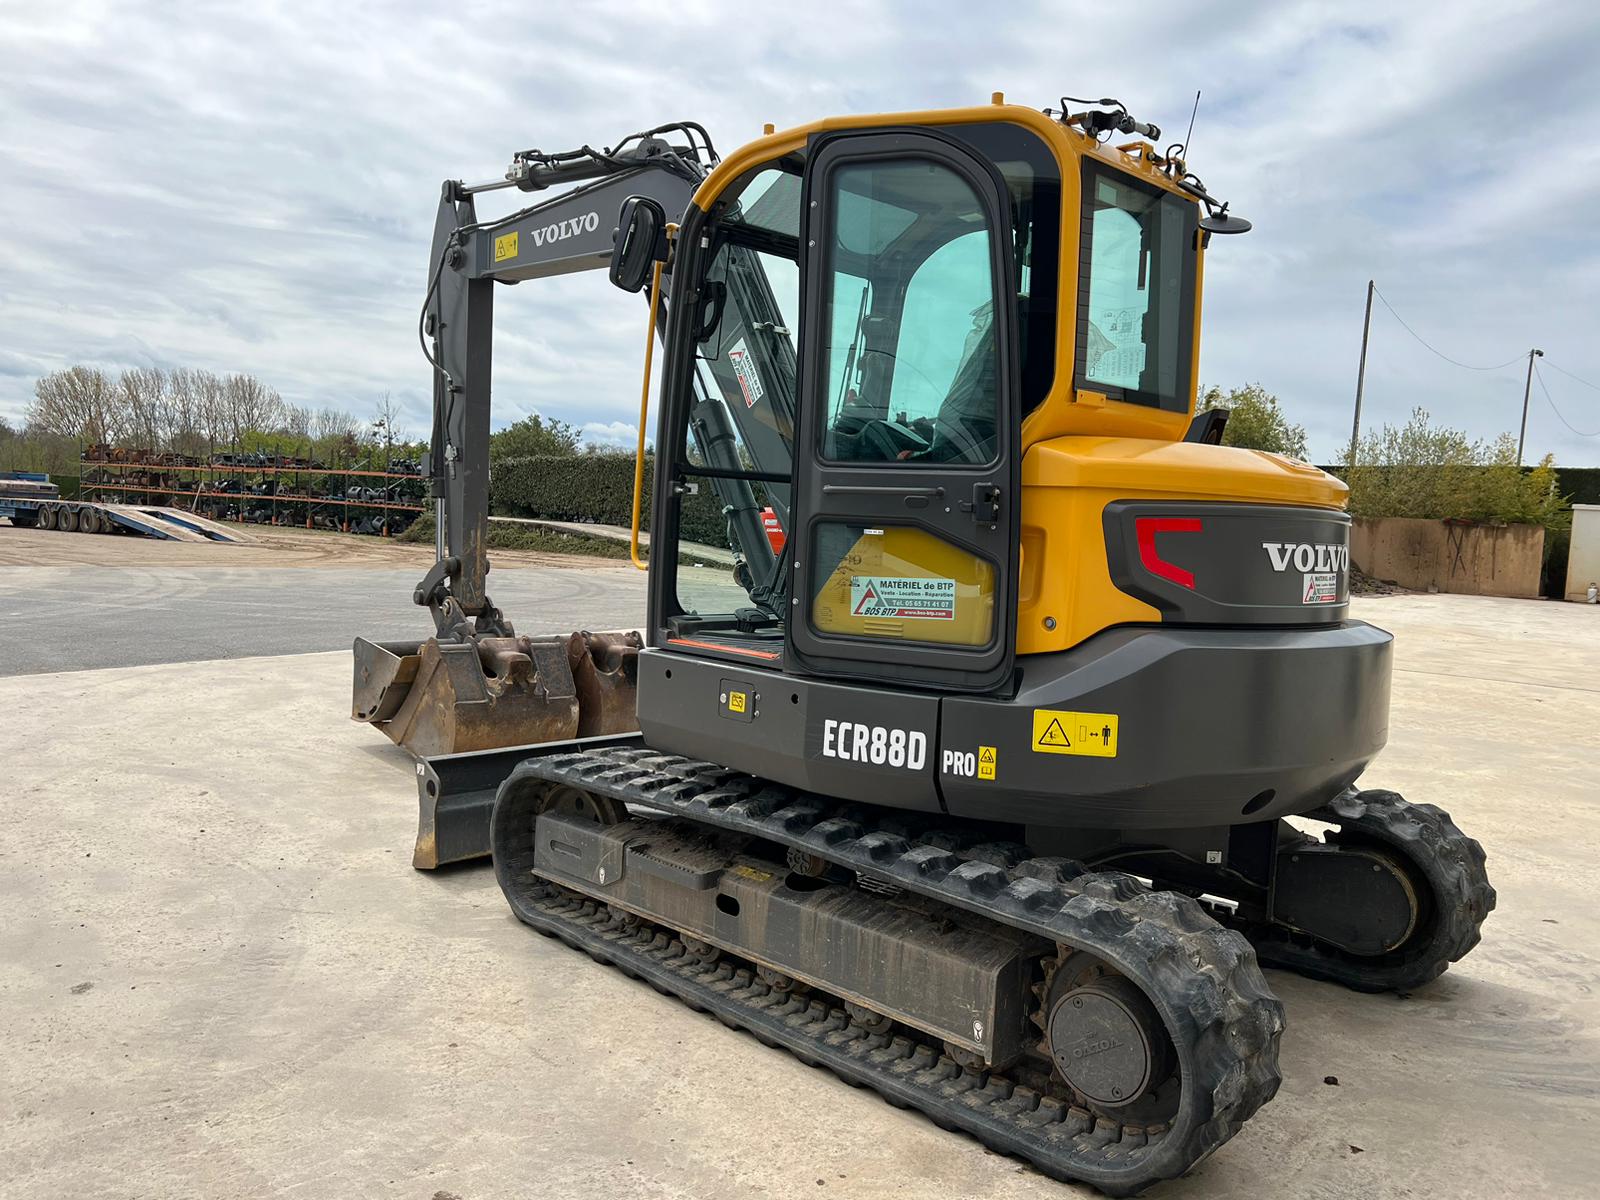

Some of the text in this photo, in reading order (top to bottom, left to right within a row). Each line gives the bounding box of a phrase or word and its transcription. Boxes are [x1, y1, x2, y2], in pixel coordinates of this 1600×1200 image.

[531, 211, 599, 247] VOLVO
[1262, 543, 1348, 572] VOLVO
[924, 582, 935, 590] de
[937, 582, 954, 590] BTP
[864, 607, 897, 616] BOS BTP
[822, 719, 927, 770] ECR88D
[942, 750, 975, 777] PRO
